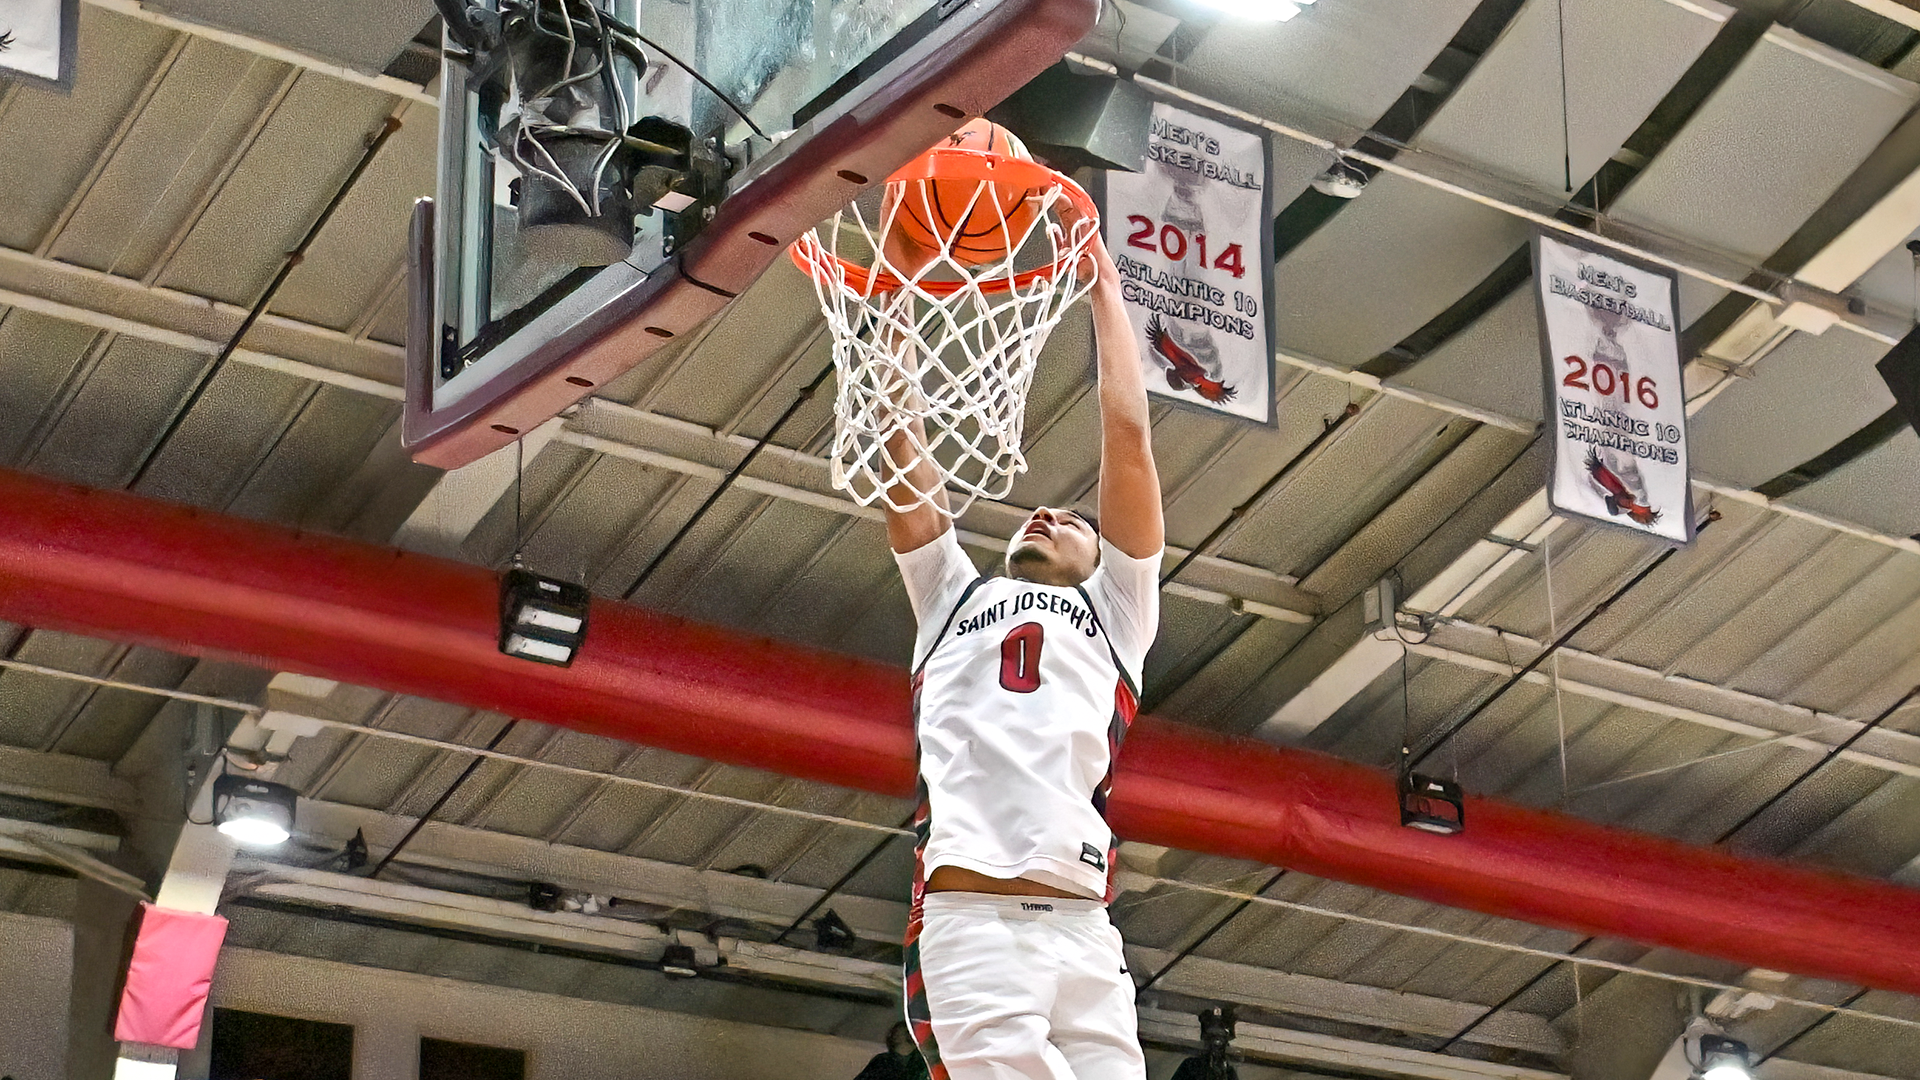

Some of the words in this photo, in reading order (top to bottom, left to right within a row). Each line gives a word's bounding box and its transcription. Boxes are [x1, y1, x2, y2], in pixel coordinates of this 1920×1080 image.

[1150, 117, 1220, 156] MEN'S
[1147, 143, 1262, 190] SKETBALL
[1126, 214, 1246, 279] 2014
[1117, 254, 1225, 307] ATLANTIC
[1233, 290, 1257, 317] 10
[1549, 274, 1671, 331] BASKETBALL
[1577, 262, 1638, 299] MEN'S
[1120, 279, 1254, 340] CHAMPIONS
[1562, 355, 1660, 411] 2016
[1655, 421, 1681, 444] 10
[956, 599, 1008, 636] SAINT
[1012, 591, 1098, 638] JOSEPH'S
[998, 621, 1044, 694] 0
